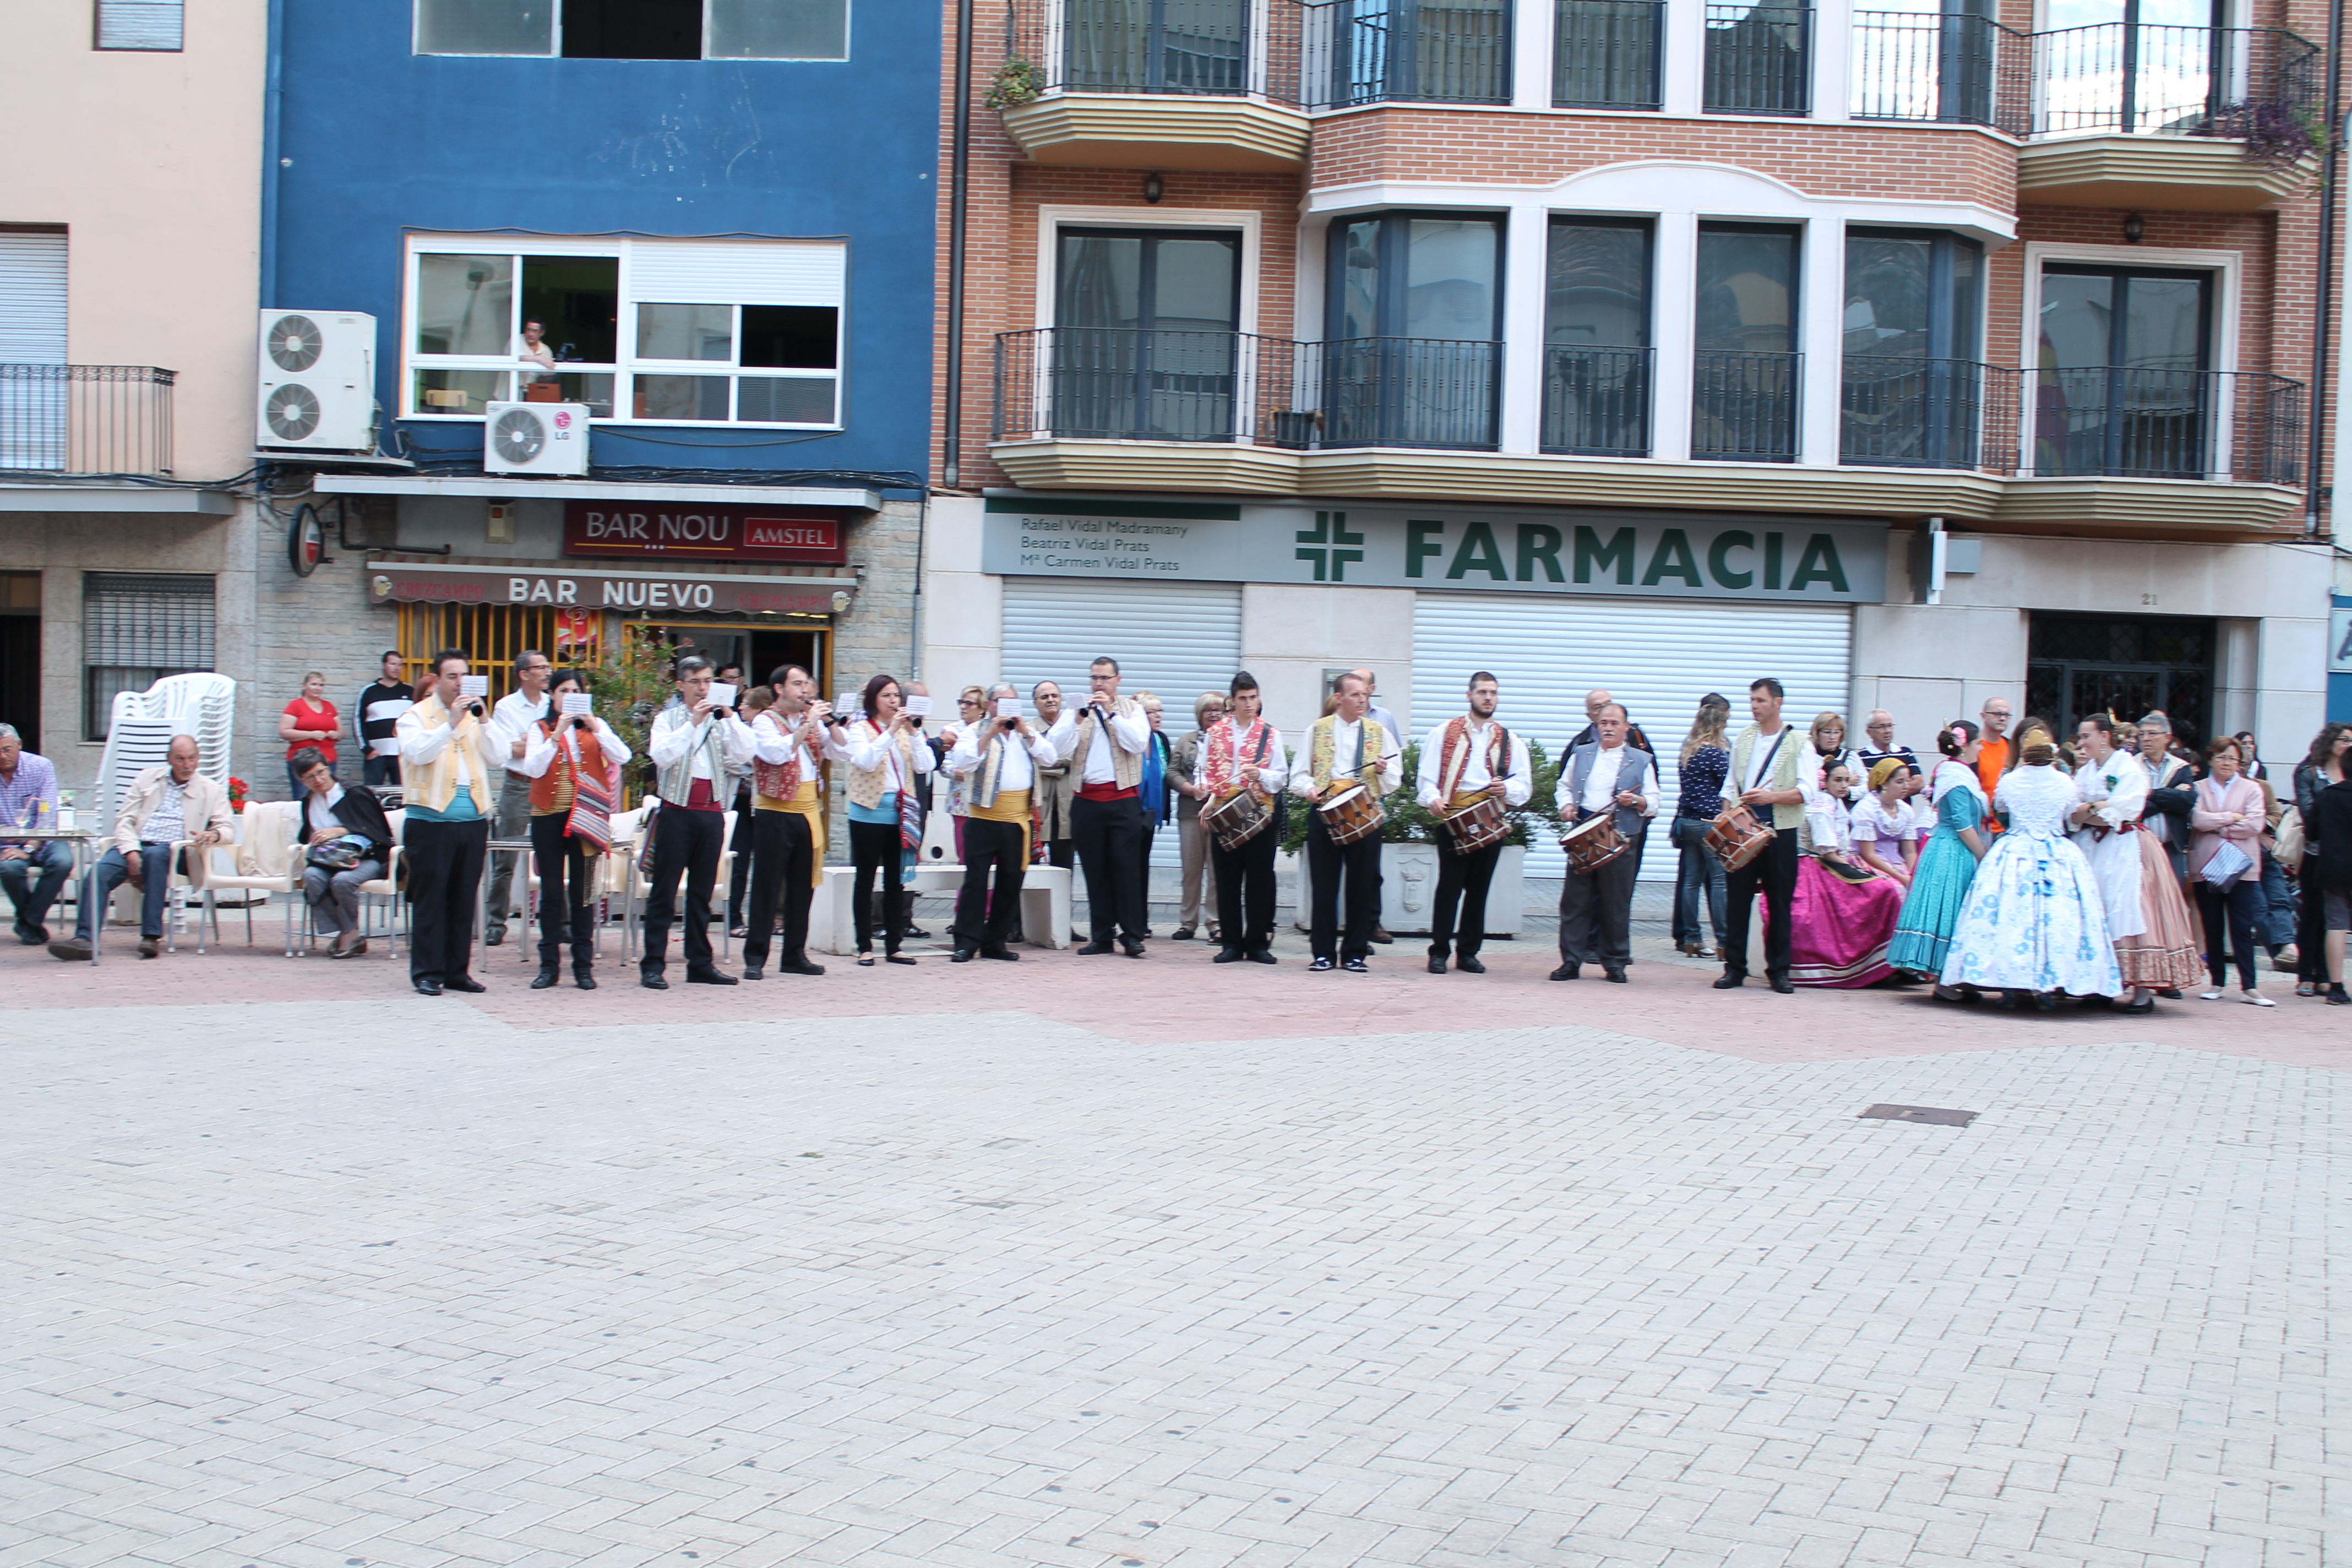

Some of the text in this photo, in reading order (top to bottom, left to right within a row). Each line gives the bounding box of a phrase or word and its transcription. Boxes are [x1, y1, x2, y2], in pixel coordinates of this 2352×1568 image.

[554, 432, 570, 440] LG
[587, 512, 729, 541] BAR NOU
[1021, 519, 1188, 538] Rafael Vidal Madramany
[752, 527, 827, 545] AMSTEL
[1021, 536, 1150, 552] Beatriz Vidal Prats
[1044, 554, 1101, 568] Carmen
[1104, 557, 1139, 569] Vidal
[1144, 558, 1180, 570] Prats
[1405, 519, 1850, 592] FARMACIA
[395, 582, 484, 599] CRUZCAMPO
[509, 578, 714, 608] BAR NUEVO
[739, 593, 828, 610] CRUZCAMPO
[2141, 593, 2158, 606] 21
